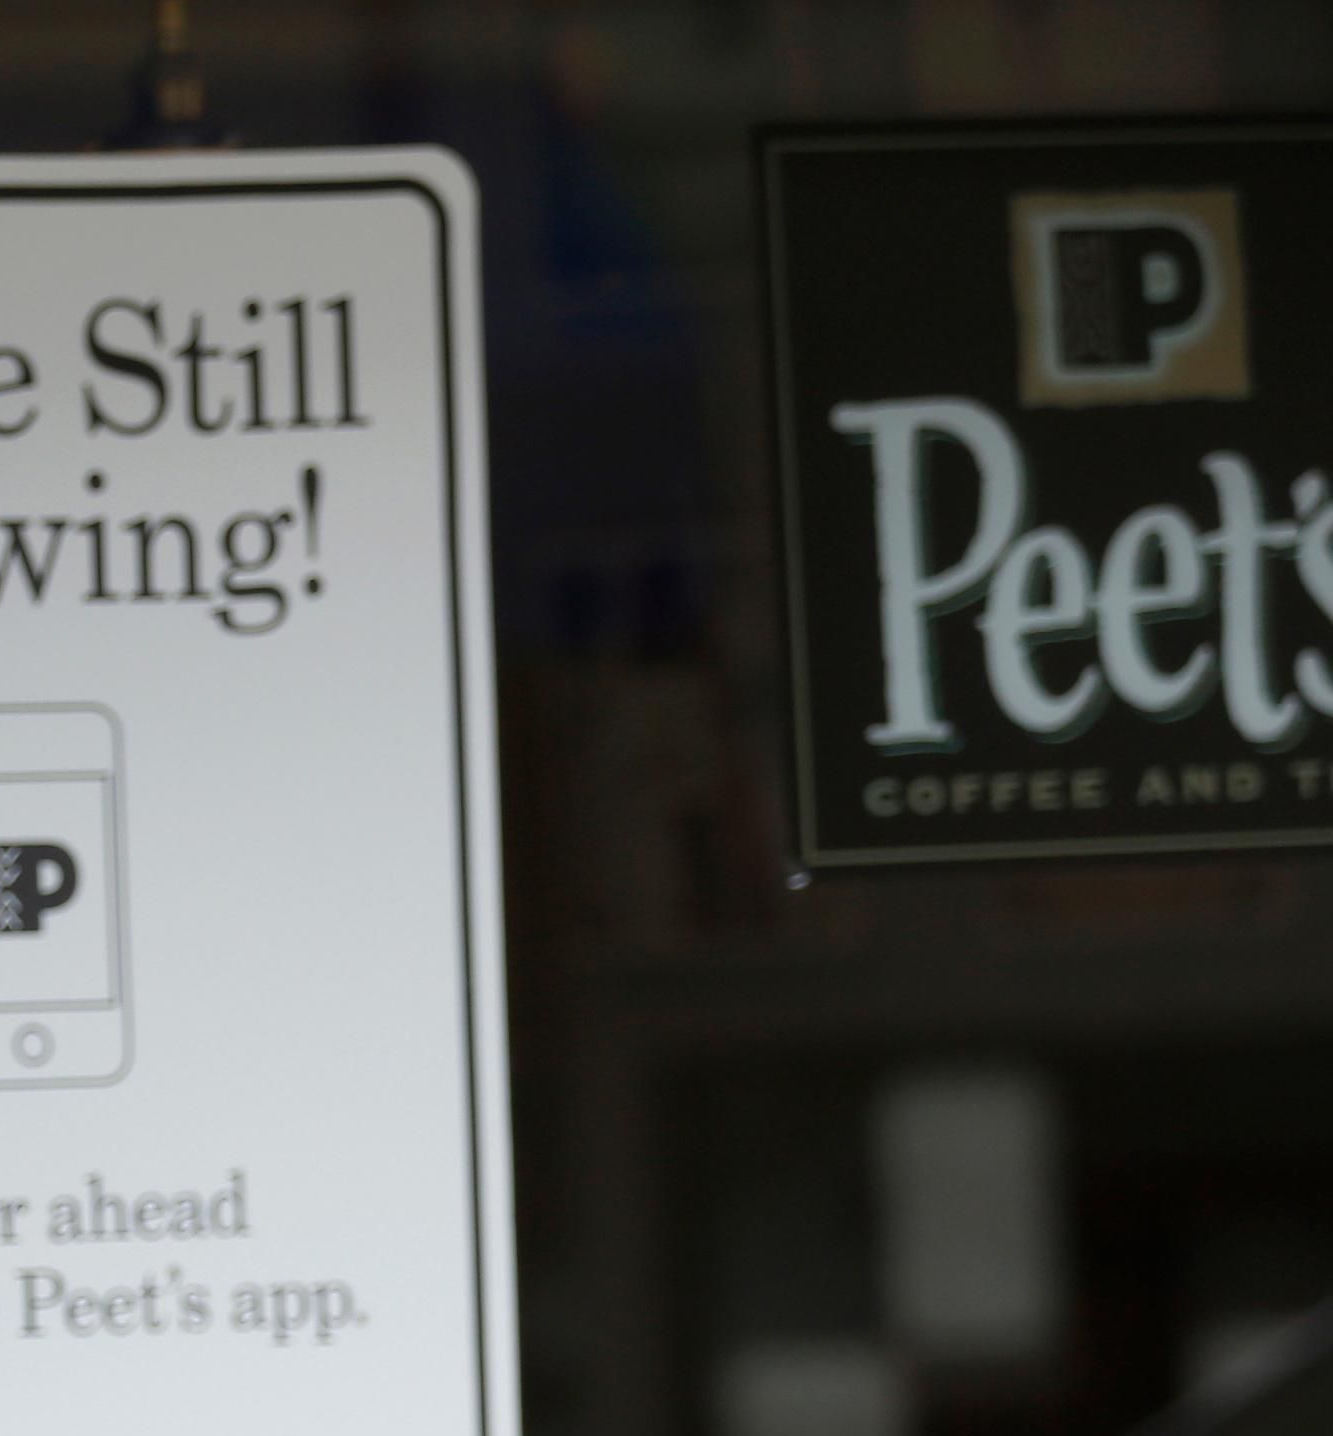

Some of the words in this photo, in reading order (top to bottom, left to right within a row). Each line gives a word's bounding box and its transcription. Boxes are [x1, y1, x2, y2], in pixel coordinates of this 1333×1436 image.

[83, 295, 367, 437] Still
[862, 768, 1107, 819] COFFEE
[1133, 761, 1265, 804] AND
[1287, 758, 1333, 801] T
[46, 1168, 251, 1242] ahead
[16, 1266, 212, 1339] Peet's
[229, 1276, 369, 1346] app.
